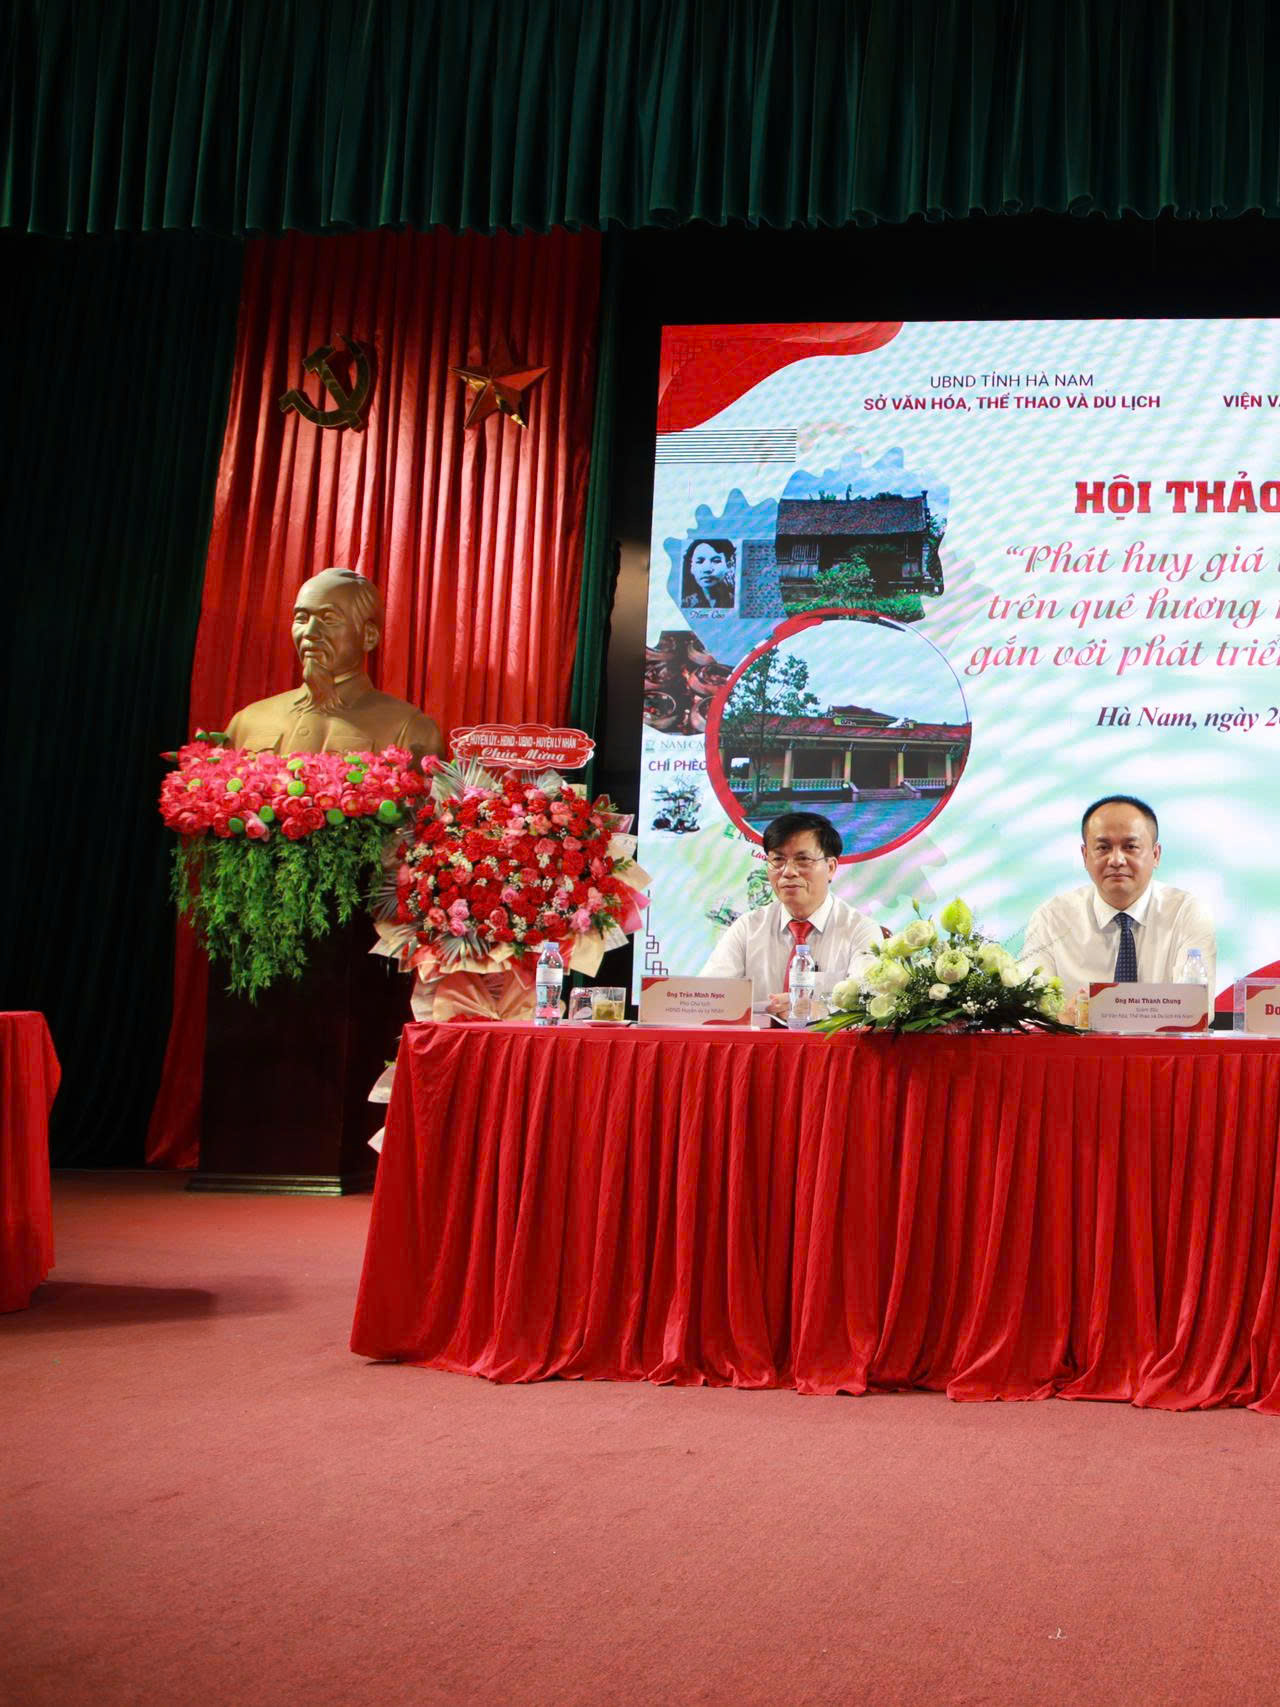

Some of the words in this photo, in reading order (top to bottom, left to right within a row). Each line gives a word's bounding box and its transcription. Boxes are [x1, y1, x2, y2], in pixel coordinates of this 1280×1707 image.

[931, 376, 976, 388] UBND
[982, 372, 1020, 387] TỈNH
[1026, 374, 1049, 386] HÀ
[1055, 375, 1093, 386] NAM
[864, 394, 887, 410] SỞ
[892, 395, 926, 410] VĂN
[931, 394, 971, 411] HÓA,
[976, 391, 1010, 410] THỂ
[1014, 396, 1060, 408] THAO
[1066, 393, 1088, 408] VÀ
[1094, 396, 1116, 408] DU
[1122, 396, 1160, 410] LỊCH
[1223, 392, 1262, 409] VIỆN
[1075, 474, 1151, 520] HỘI
[1122, 541, 1196, 581] huy
[1202, 546, 1268, 582] giá
[988, 593, 1066, 619] trên
[1070, 593, 1139, 628] quê
[1146, 588, 1264, 628] hương
[964, 635, 1043, 676] gắn
[1053, 639, 1111, 666] với
[1117, 635, 1208, 675] phát
[1097, 707, 1131, 726] Hà
[1138, 707, 1197, 729] Nam,
[1204, 707, 1259, 732] ngày
